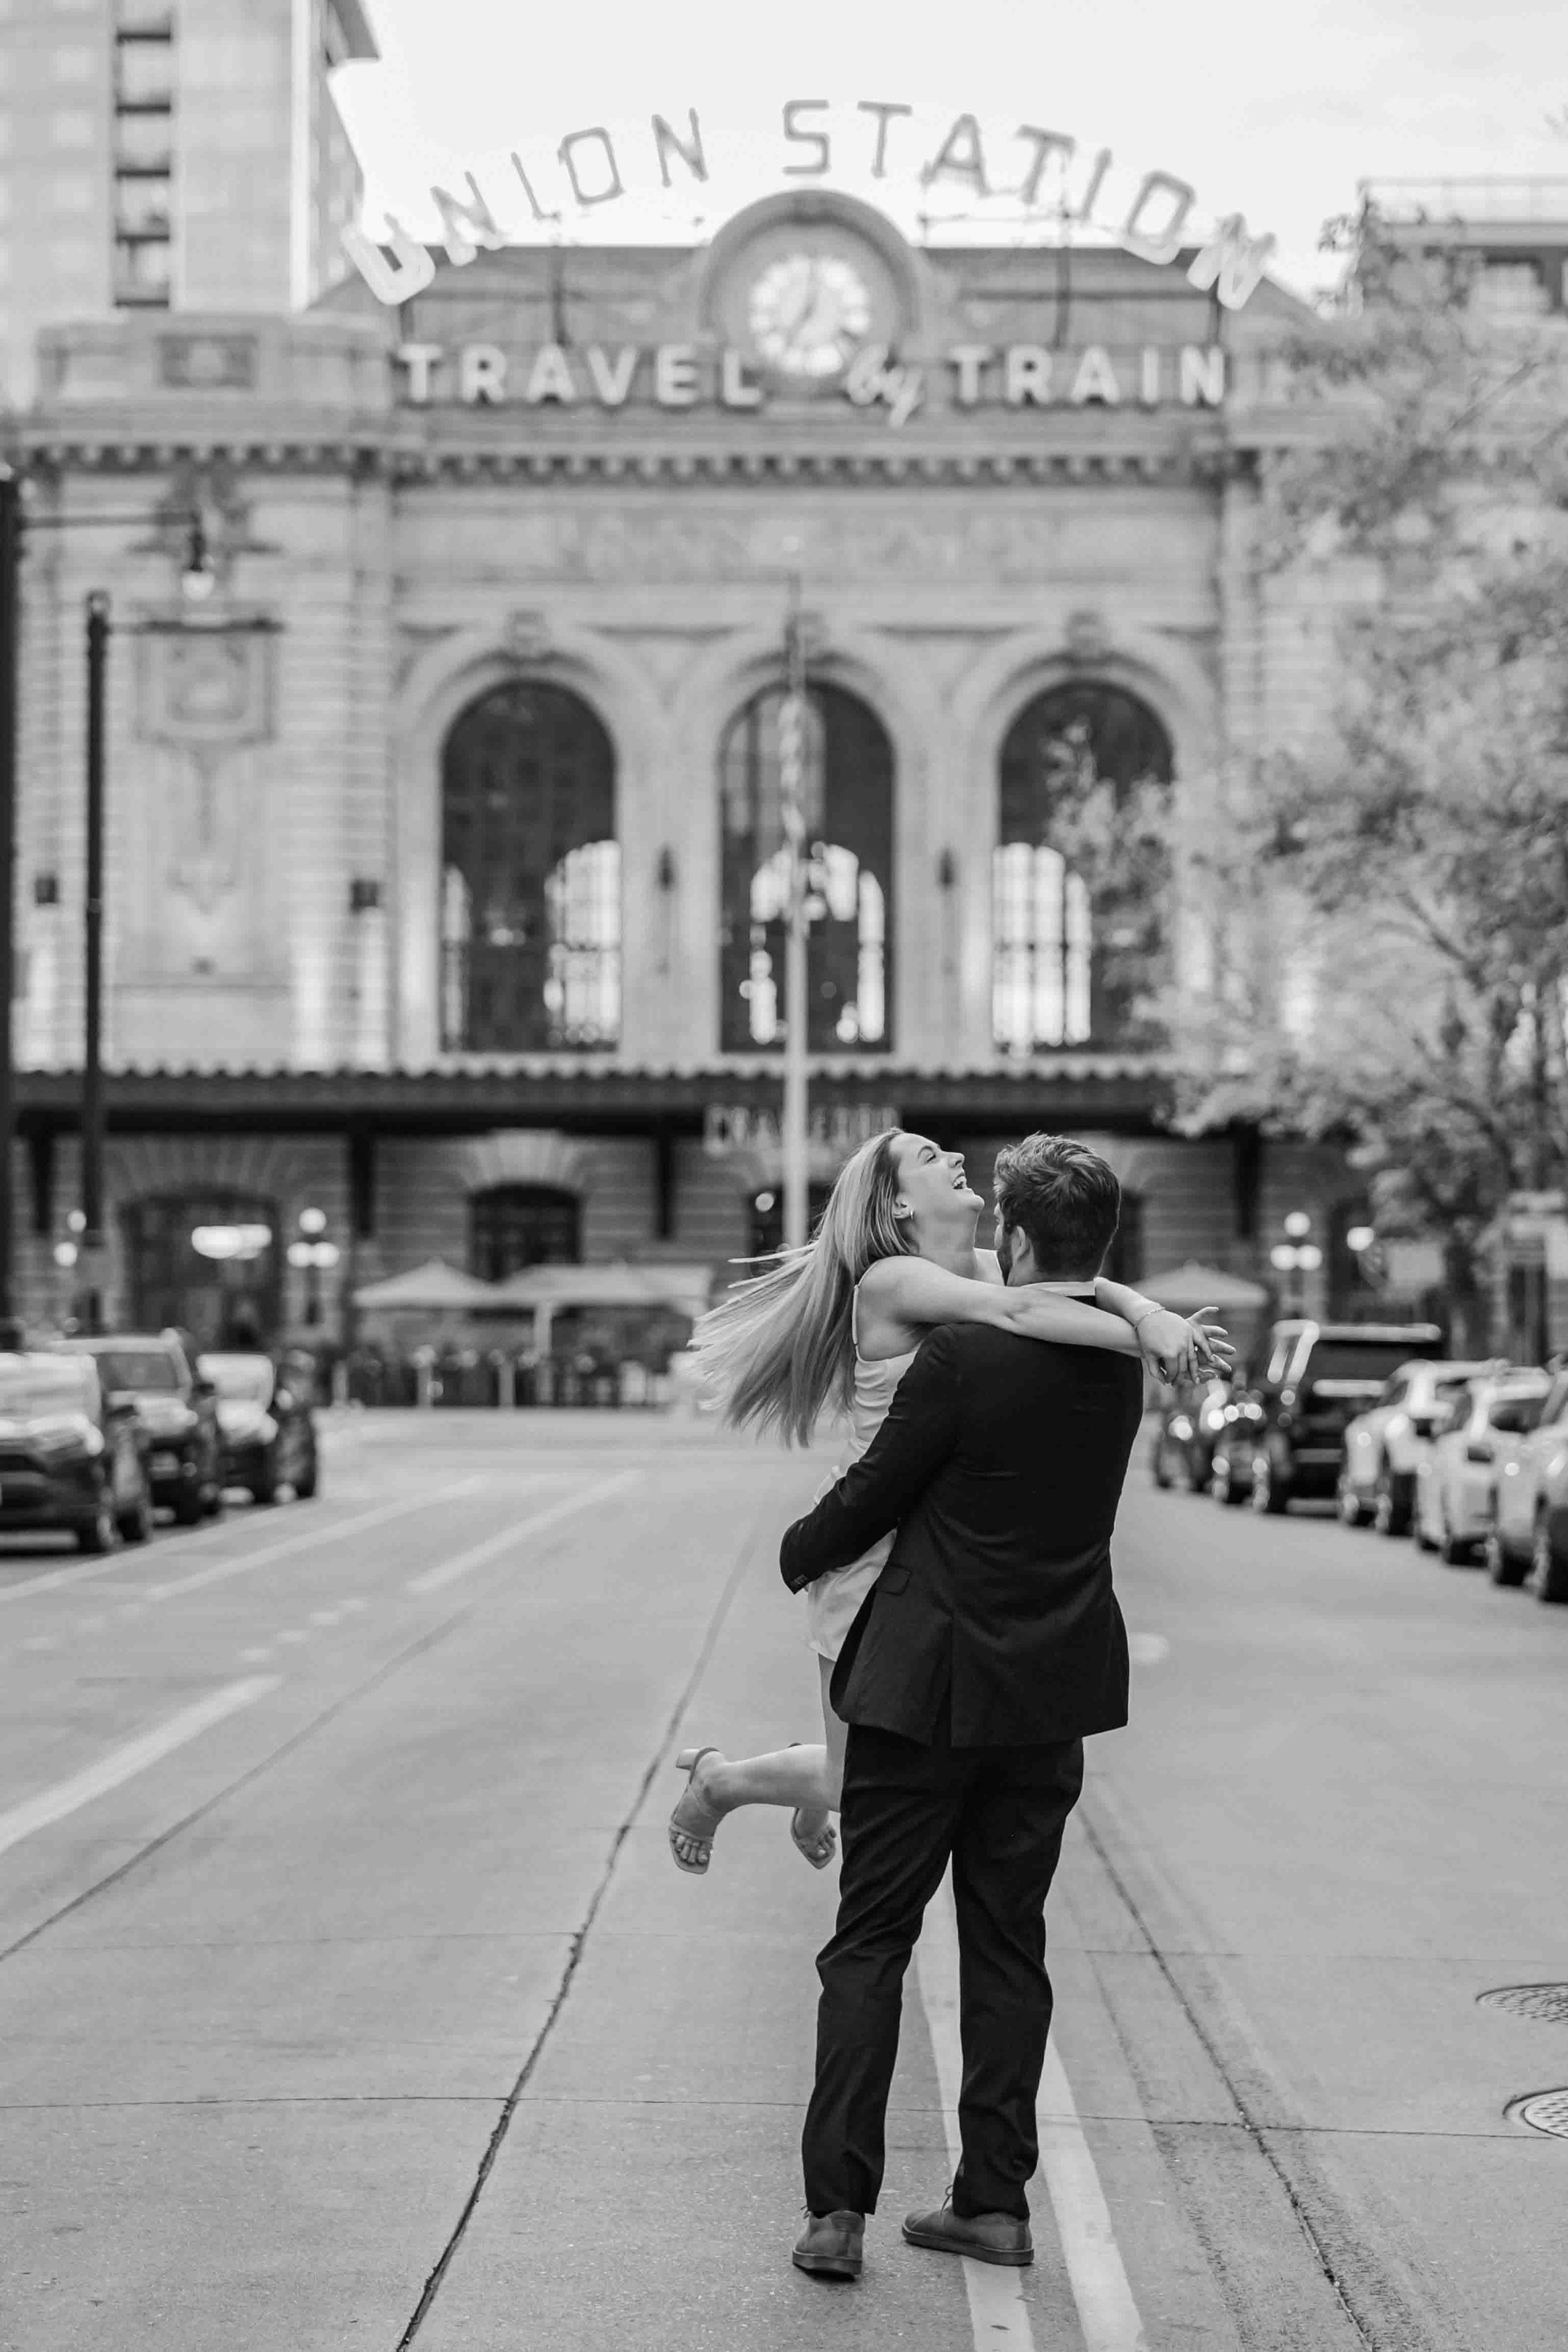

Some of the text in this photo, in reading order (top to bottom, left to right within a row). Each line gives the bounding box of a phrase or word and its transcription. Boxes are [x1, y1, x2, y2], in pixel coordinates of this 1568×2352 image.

[340, 99, 1278, 310] UNION STATION
[398, 342, 1225, 428] TRAVEL by TRAIN
